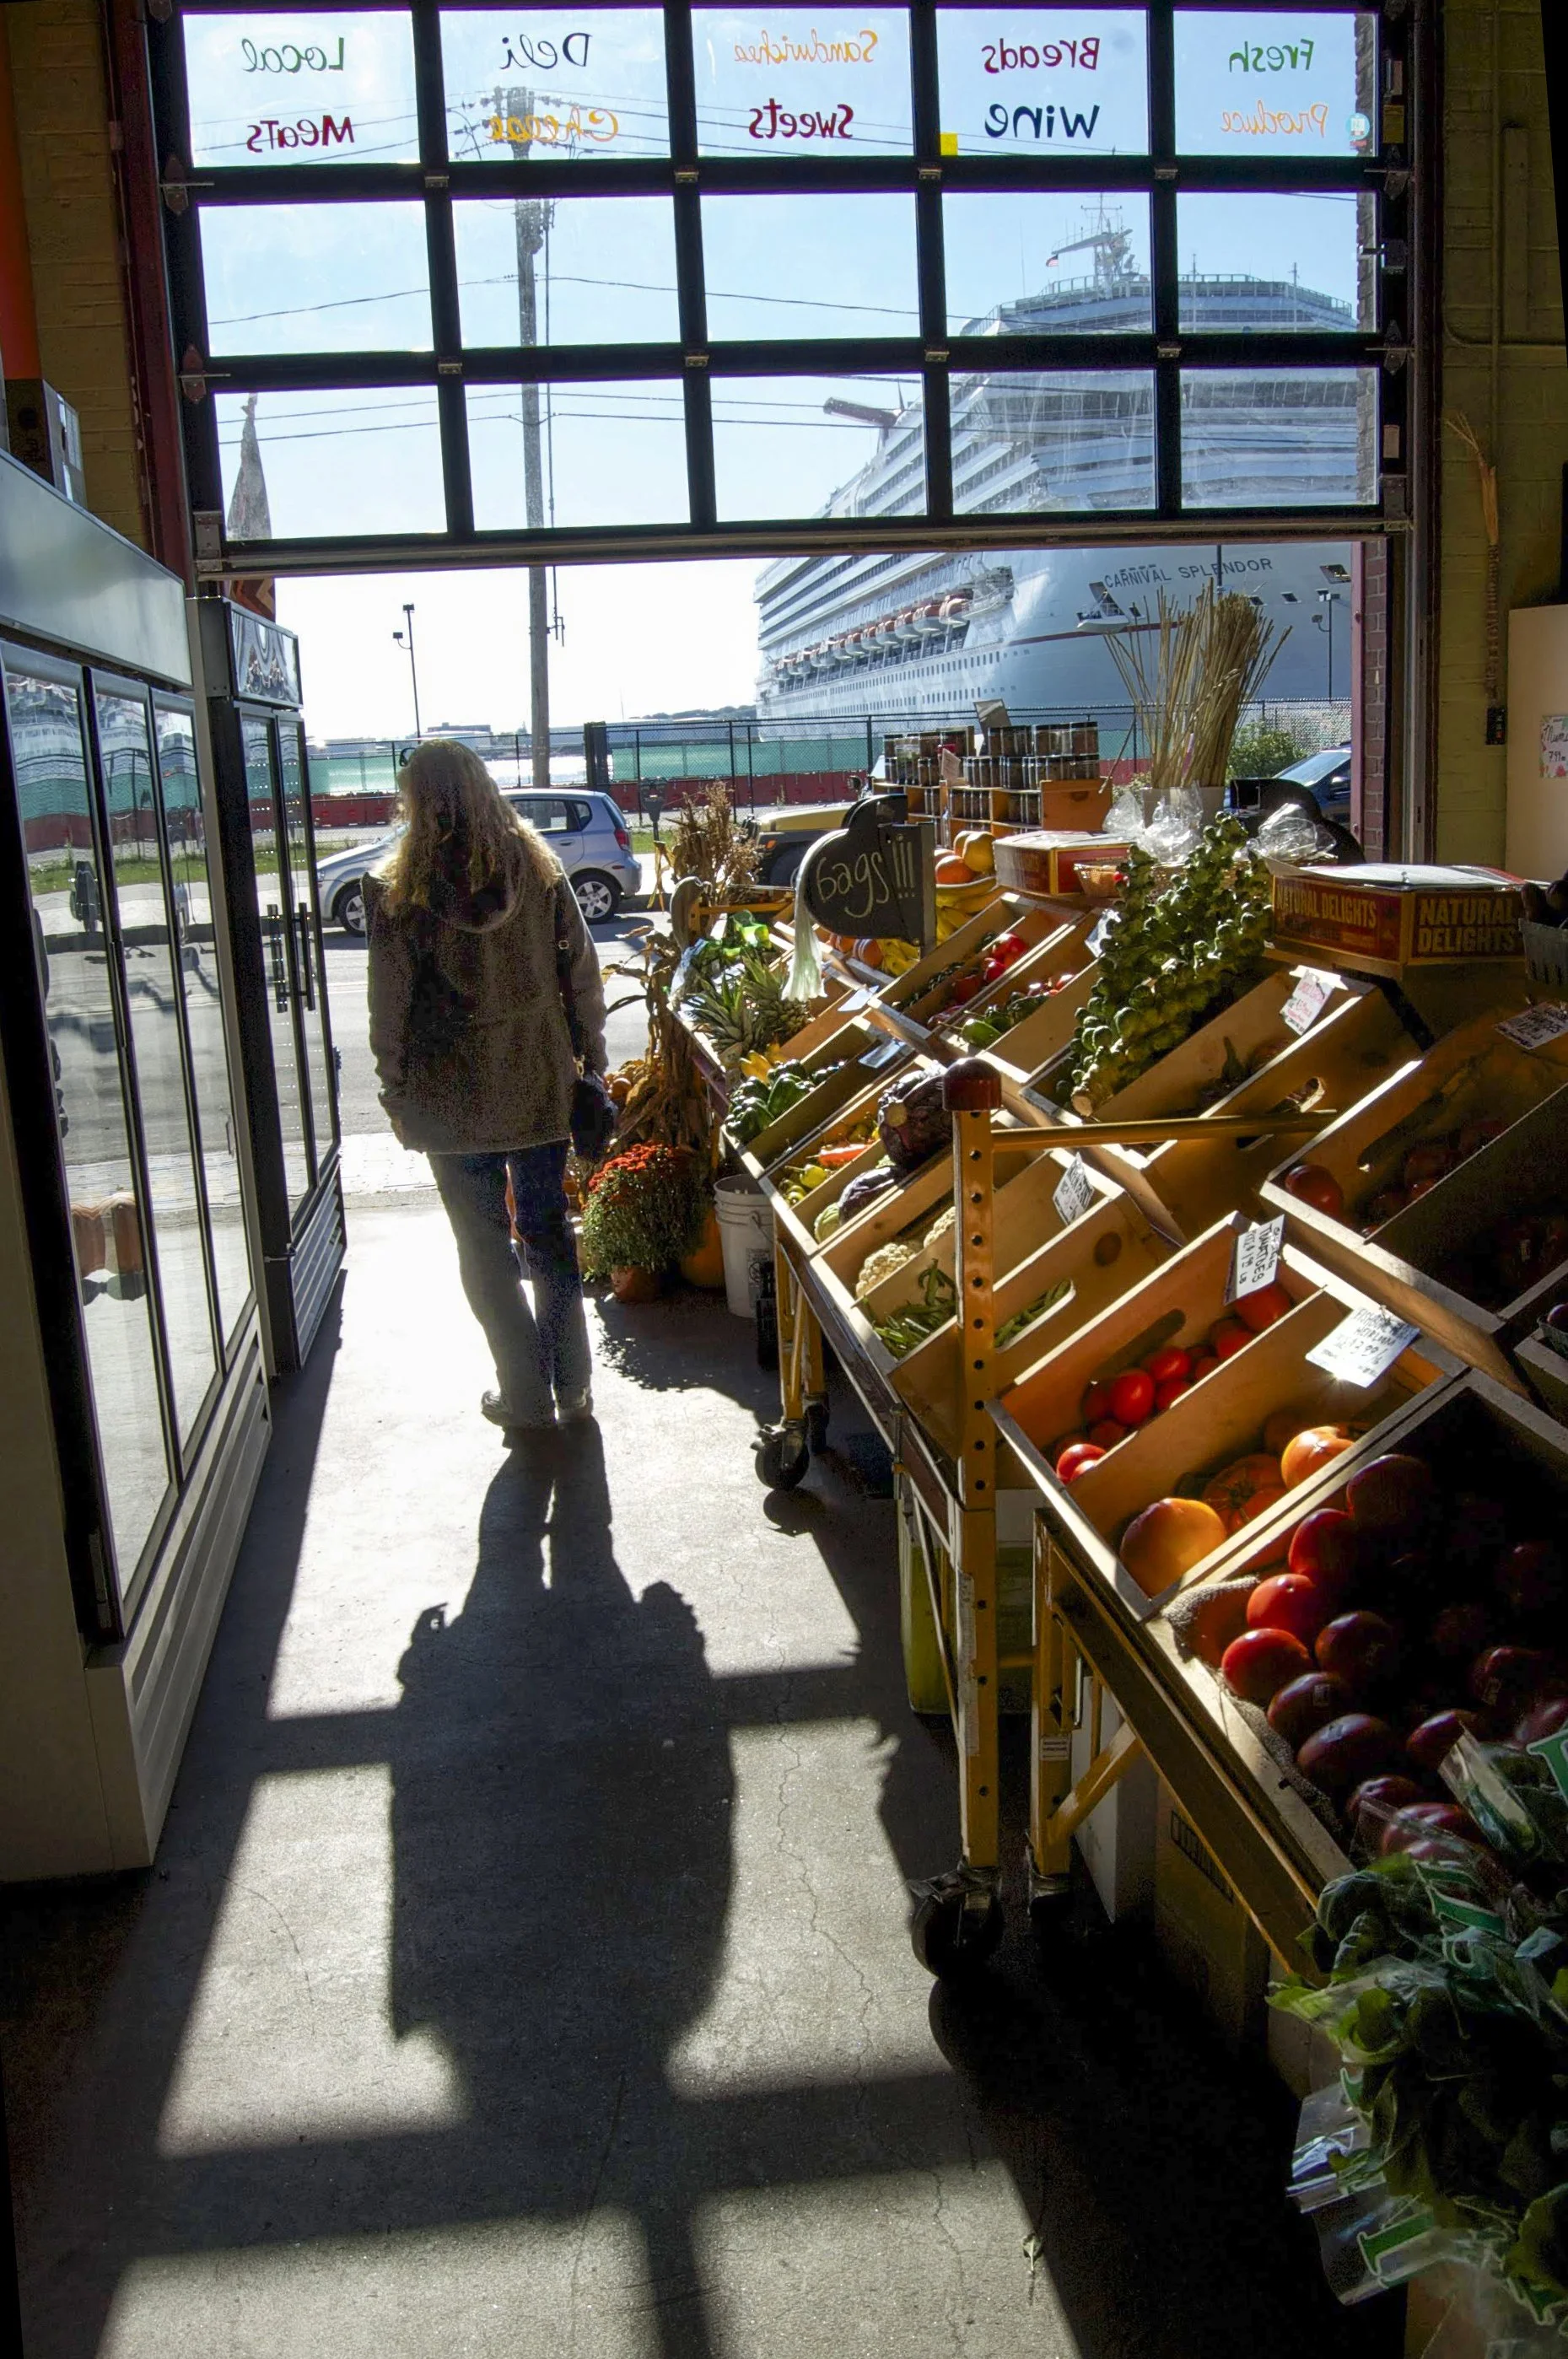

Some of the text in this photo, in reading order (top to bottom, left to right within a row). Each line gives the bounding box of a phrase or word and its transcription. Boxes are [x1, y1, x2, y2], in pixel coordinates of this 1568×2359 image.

[1104, 557, 1273, 589] CARNIVAL SPLENDOR
[1276, 885, 1378, 929] NATURAL DELIGHTS
[1418, 897, 1514, 925] NATURAL
[1416, 926, 1516, 953] DELIGHTS
